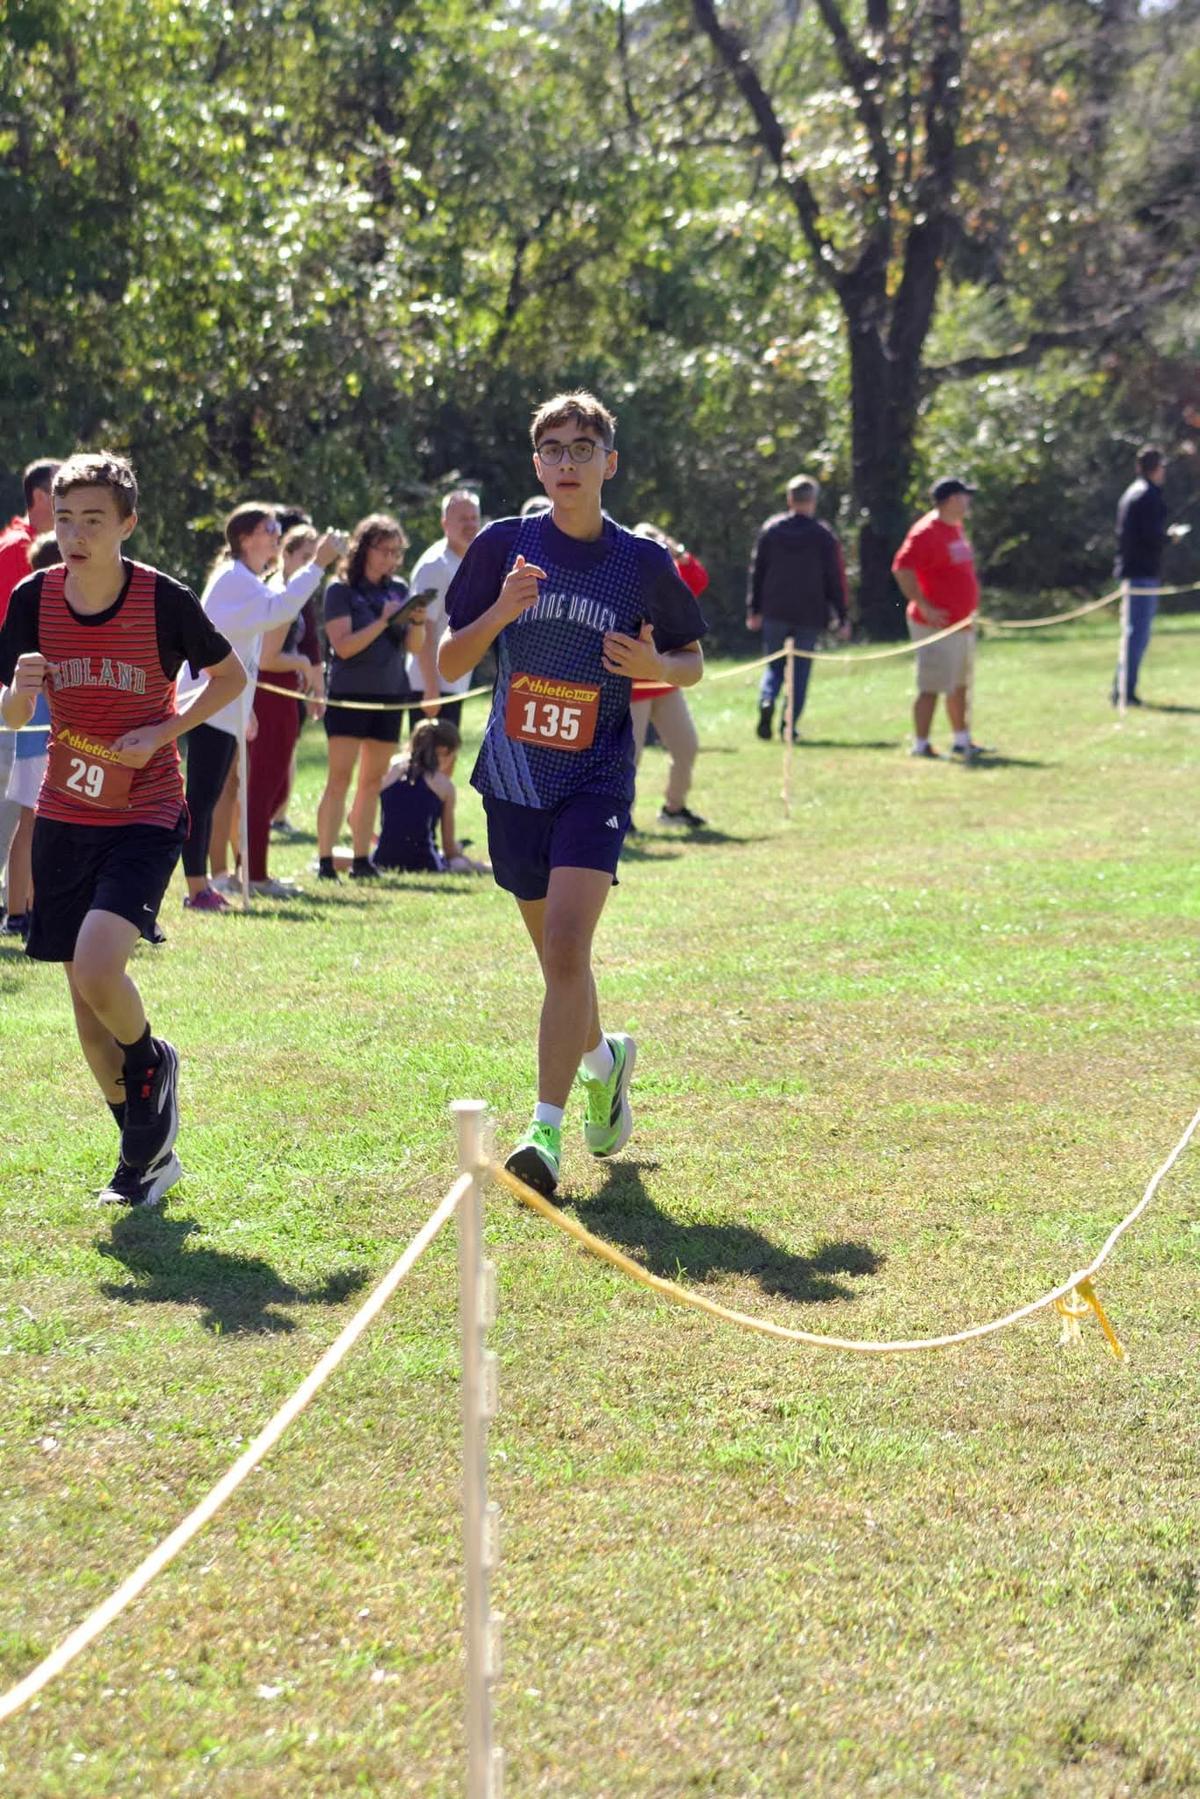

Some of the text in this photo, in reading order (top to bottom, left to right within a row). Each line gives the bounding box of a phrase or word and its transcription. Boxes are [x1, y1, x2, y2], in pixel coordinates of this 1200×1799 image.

[568, 594, 616, 632] VALLEY
[521, 700, 582, 741] 135
[66, 757, 105, 798] 29
